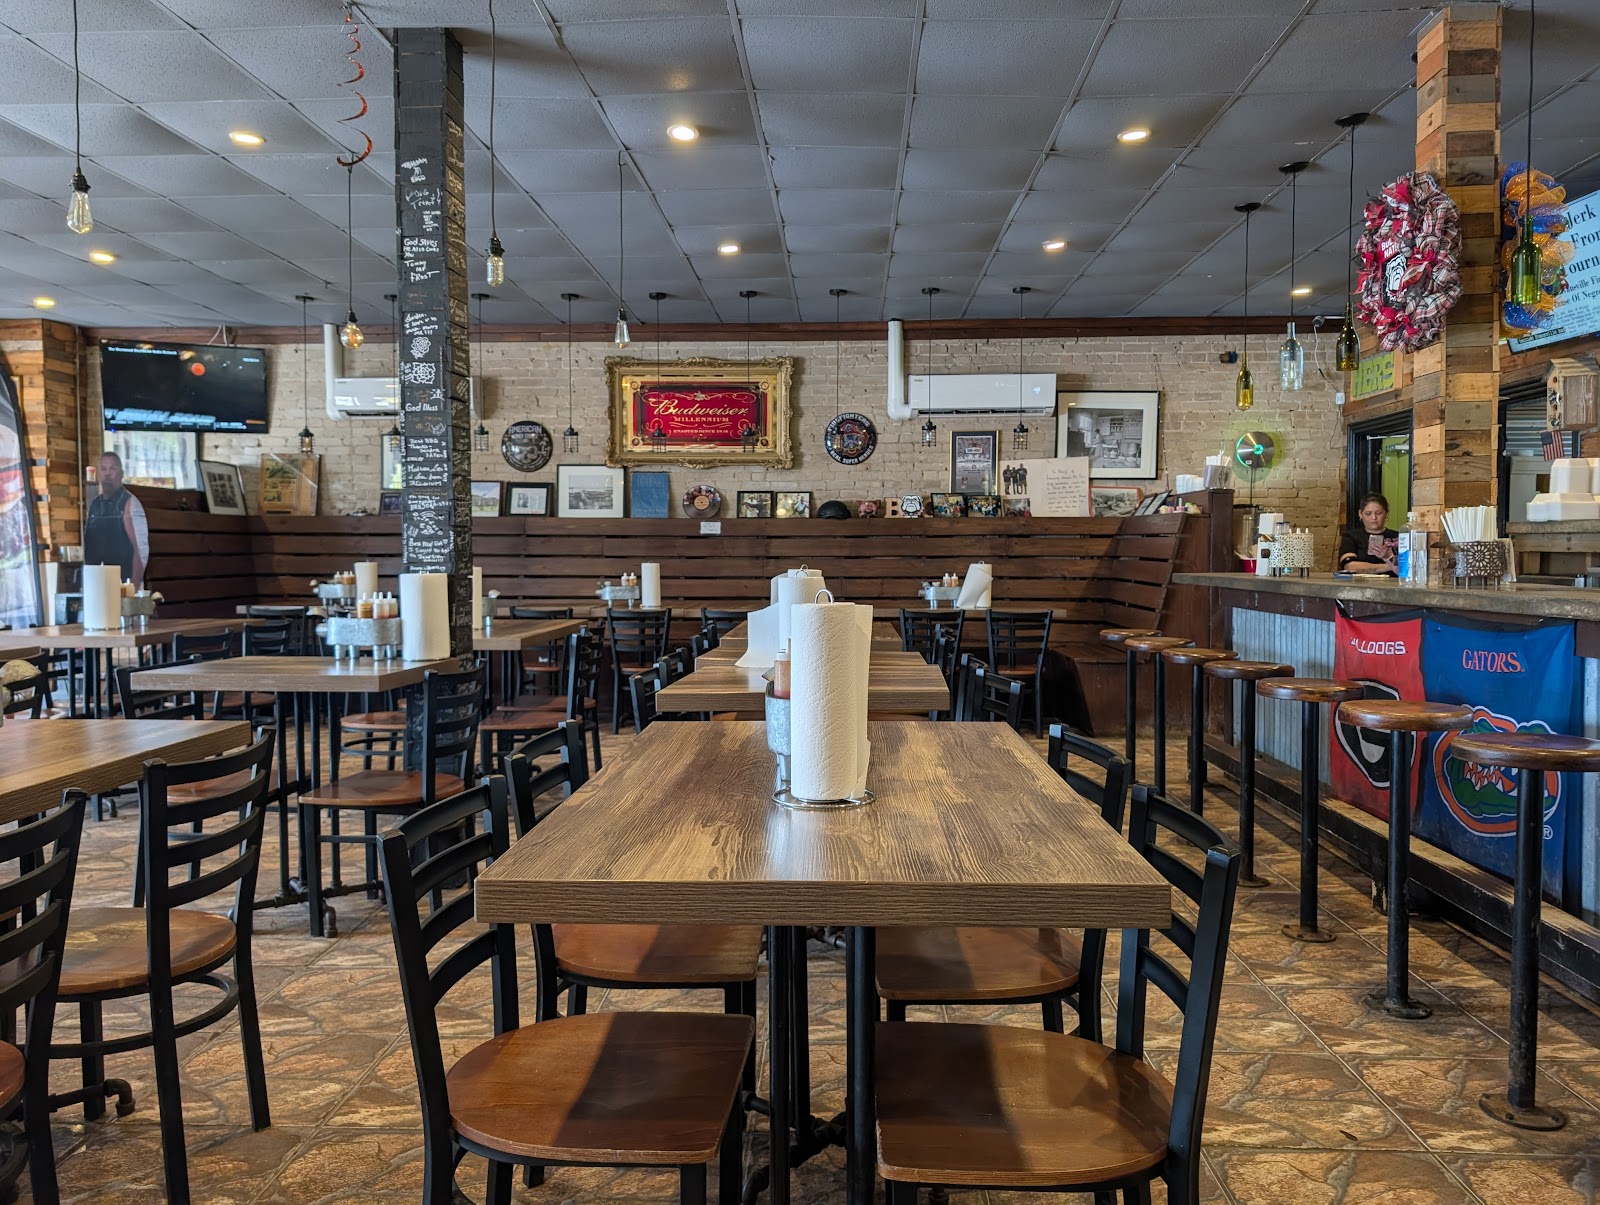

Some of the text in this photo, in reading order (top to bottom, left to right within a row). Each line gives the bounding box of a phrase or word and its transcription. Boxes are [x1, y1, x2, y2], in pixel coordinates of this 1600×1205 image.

[1567, 204, 1597, 230] Jerk
[404, 238, 418, 246] God
[1381, 238, 1394, 252] BUL
[1384, 244, 1396, 259] NAT
[1568, 255, 1600, 276] ourn
[1571, 289, 1600, 302] Of Negr
[1352, 351, 1394, 397] HERS
[405, 402, 421, 411] God
[649, 399, 749, 416] Budweiser
[508, 425, 543, 434] AMERICAN
[828, 413, 870, 431] FIREFIGHTERS
[858, 445, 874, 462] HEROES
[1463, 650, 1520, 673] GATORS
